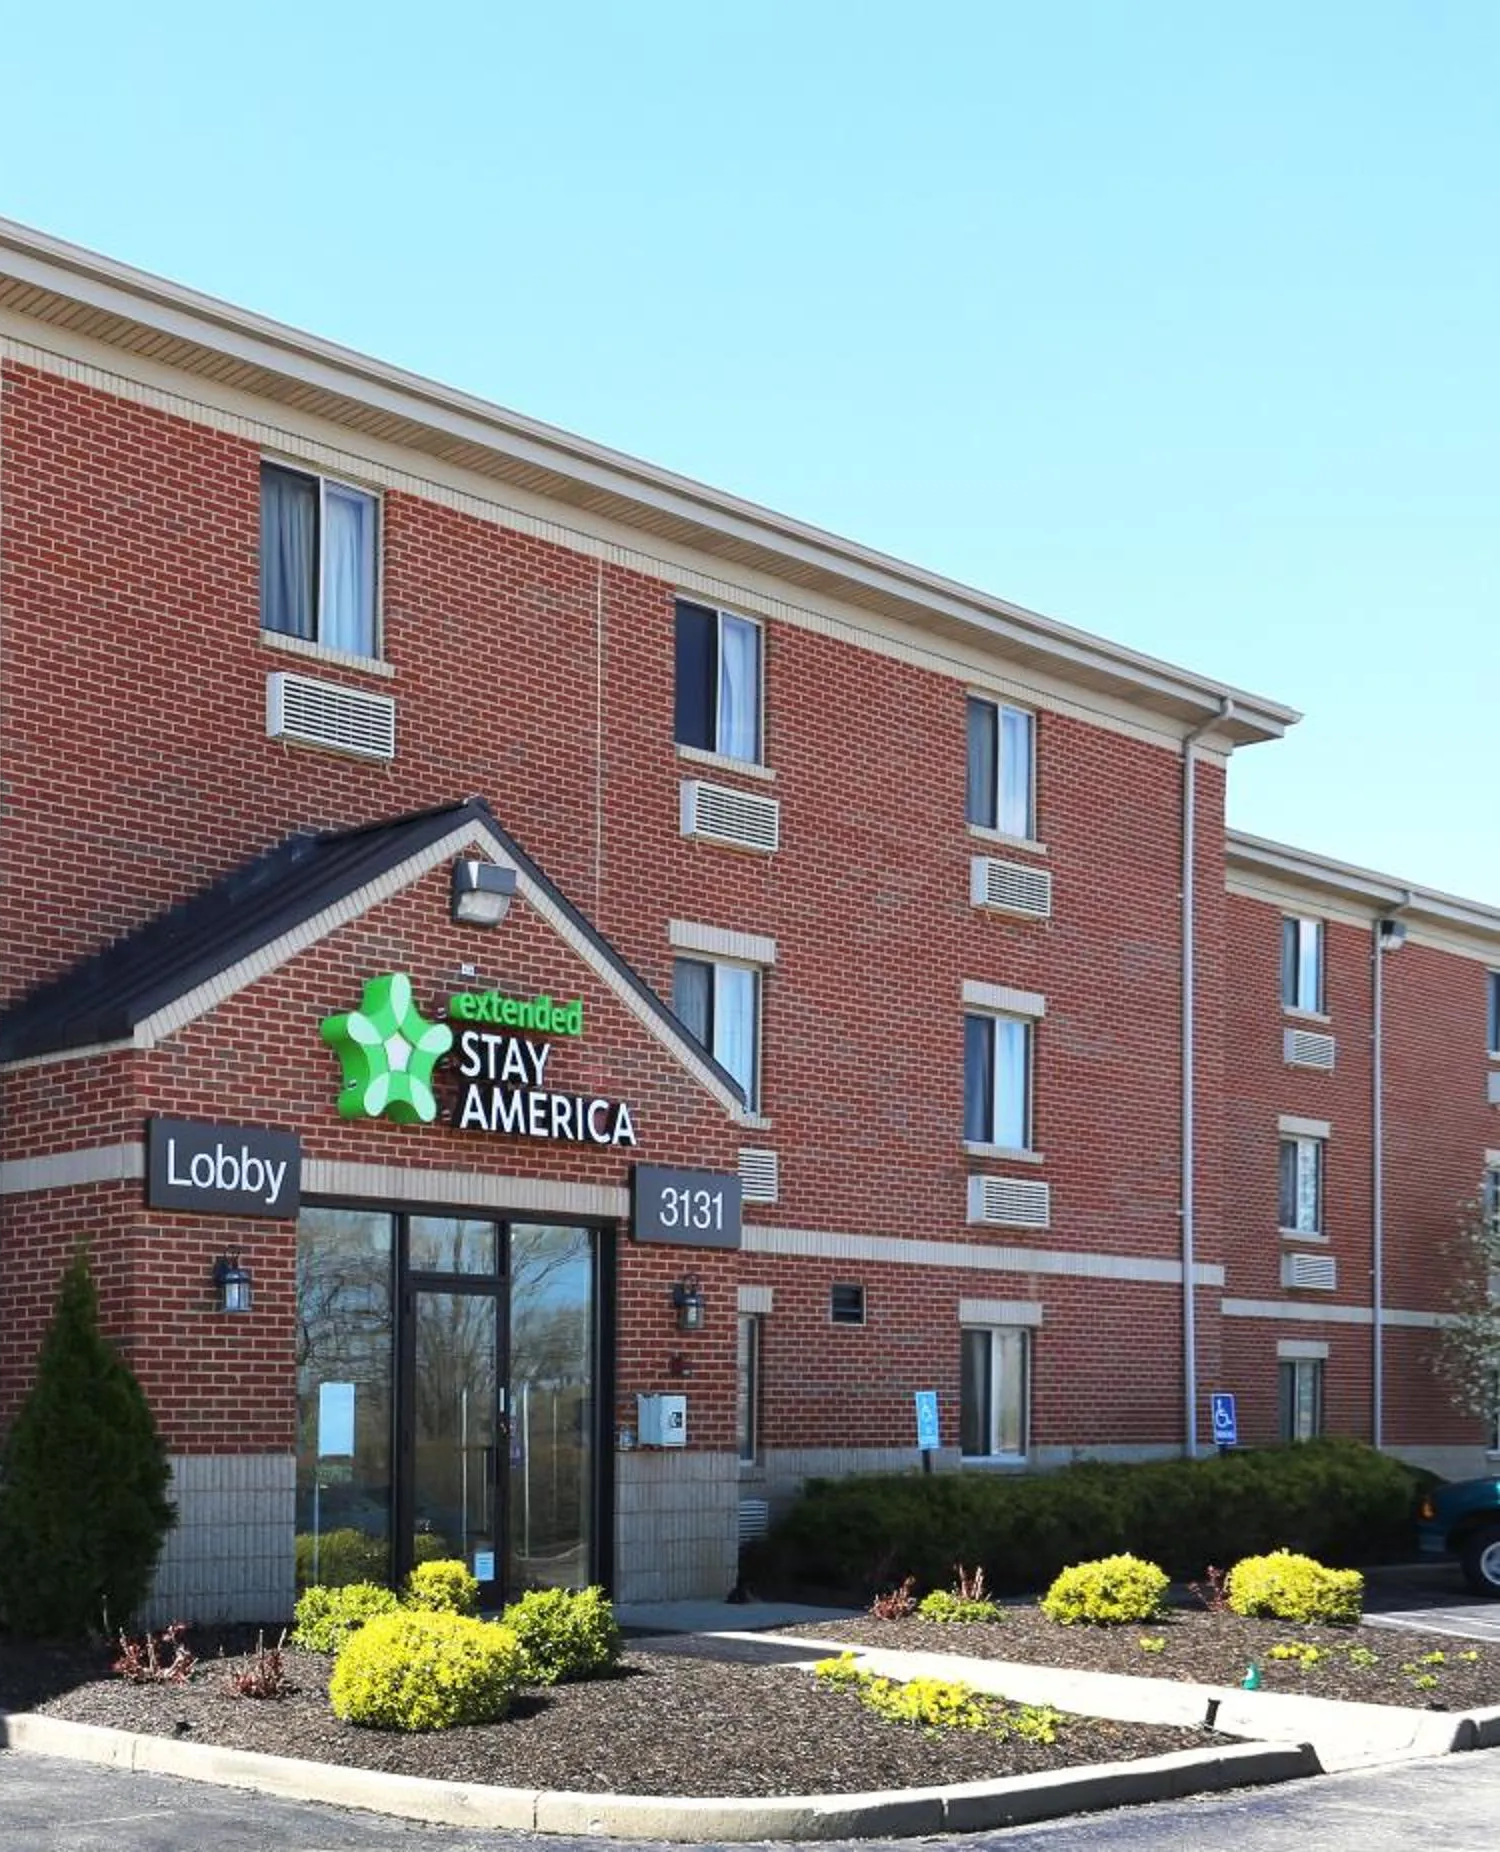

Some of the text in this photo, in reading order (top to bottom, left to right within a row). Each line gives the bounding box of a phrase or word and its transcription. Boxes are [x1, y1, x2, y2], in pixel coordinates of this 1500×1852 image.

[452, 990, 583, 1036] extended
[460, 1030, 550, 1087] STAY
[460, 1083, 637, 1146] AMERICA
[167, 1138, 287, 1205] Lobby
[660, 1187, 723, 1230] 3131
